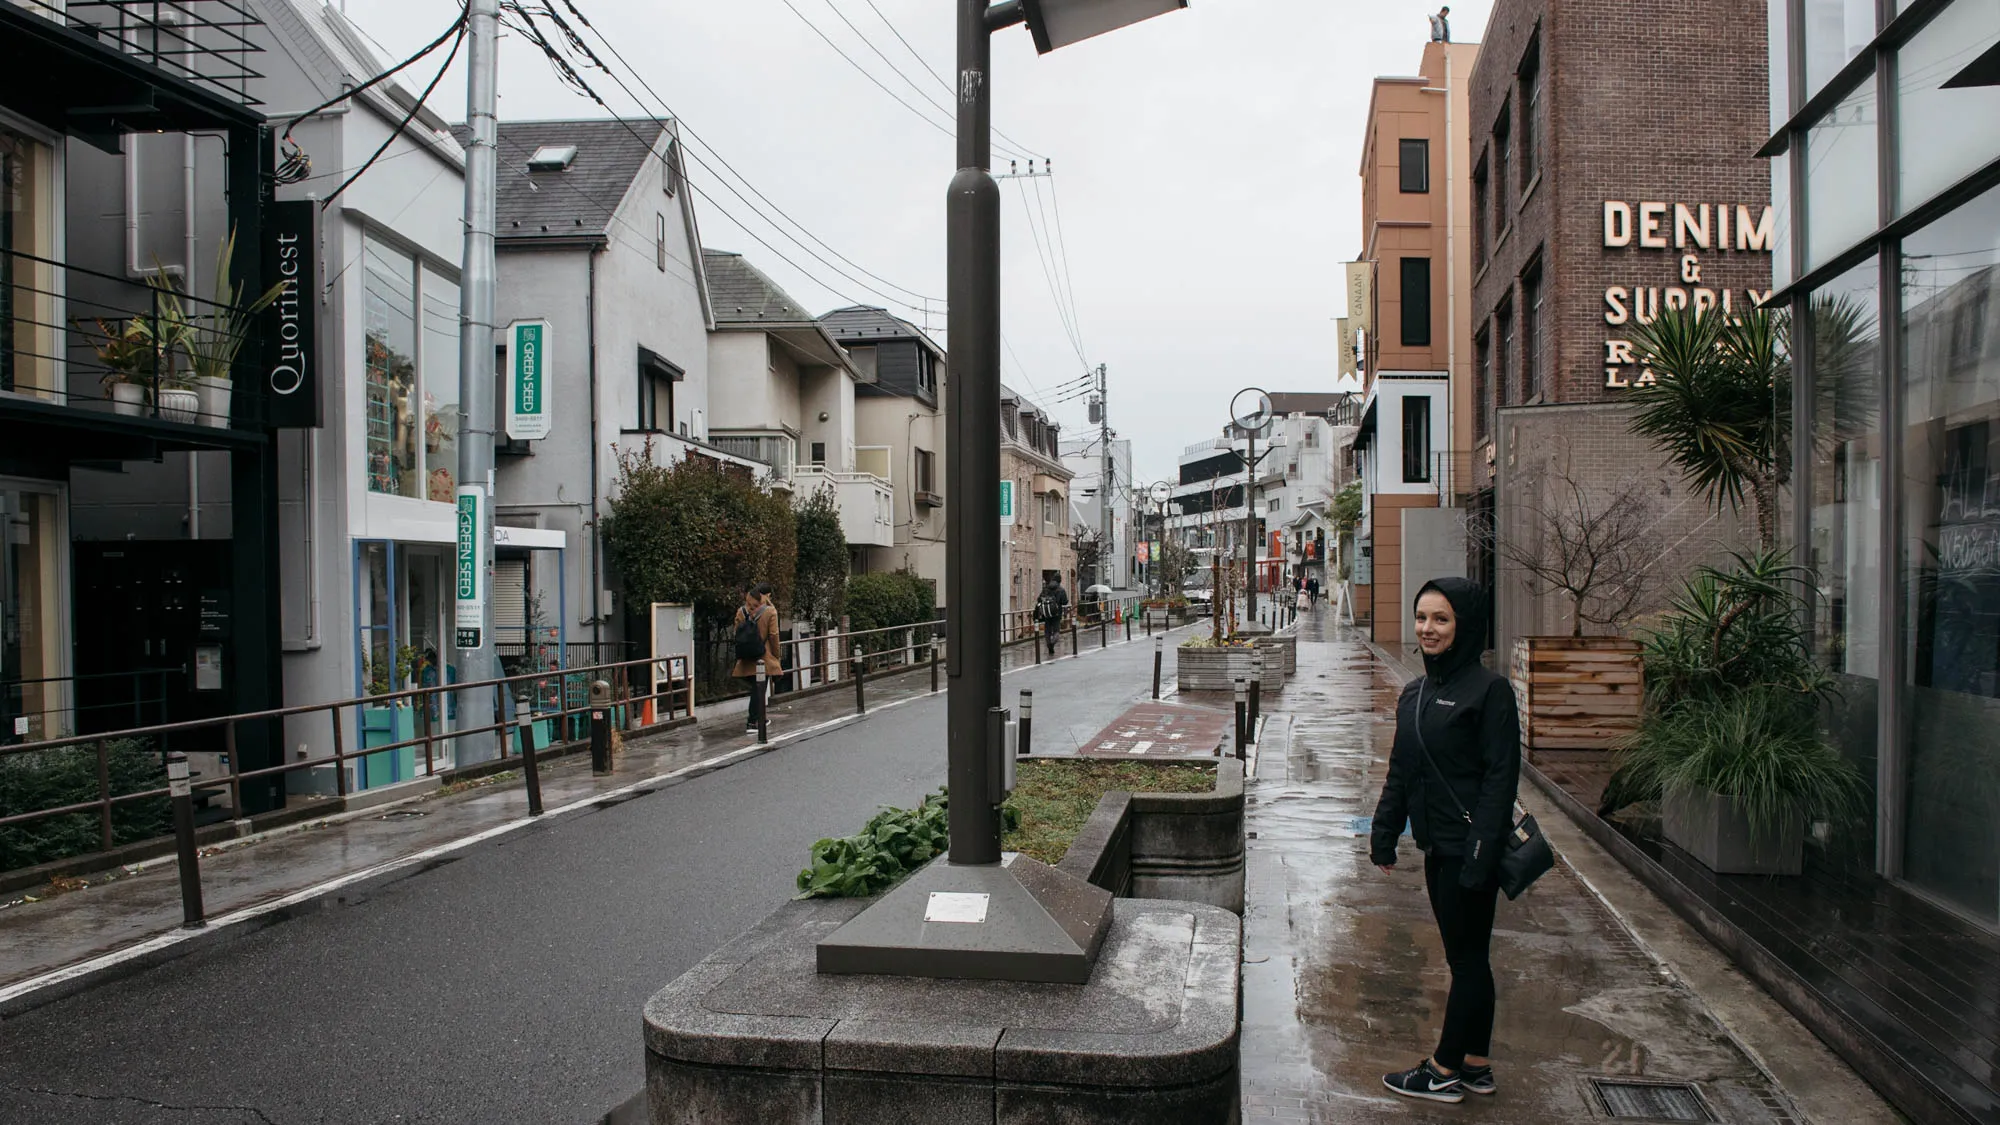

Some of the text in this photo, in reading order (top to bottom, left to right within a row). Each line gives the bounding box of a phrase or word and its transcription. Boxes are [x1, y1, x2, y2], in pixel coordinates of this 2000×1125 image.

[1604, 201, 1773, 250] DENIM
[1681, 254, 1700, 283] &
[271, 233, 306, 395] Quorinest
[1354, 273, 1363, 317] CANAAN
[523, 342, 535, 380] GREEN
[523, 382, 534, 412] SEED
[459, 514, 472, 560] GREEN
[459, 561, 472, 597] SEED
